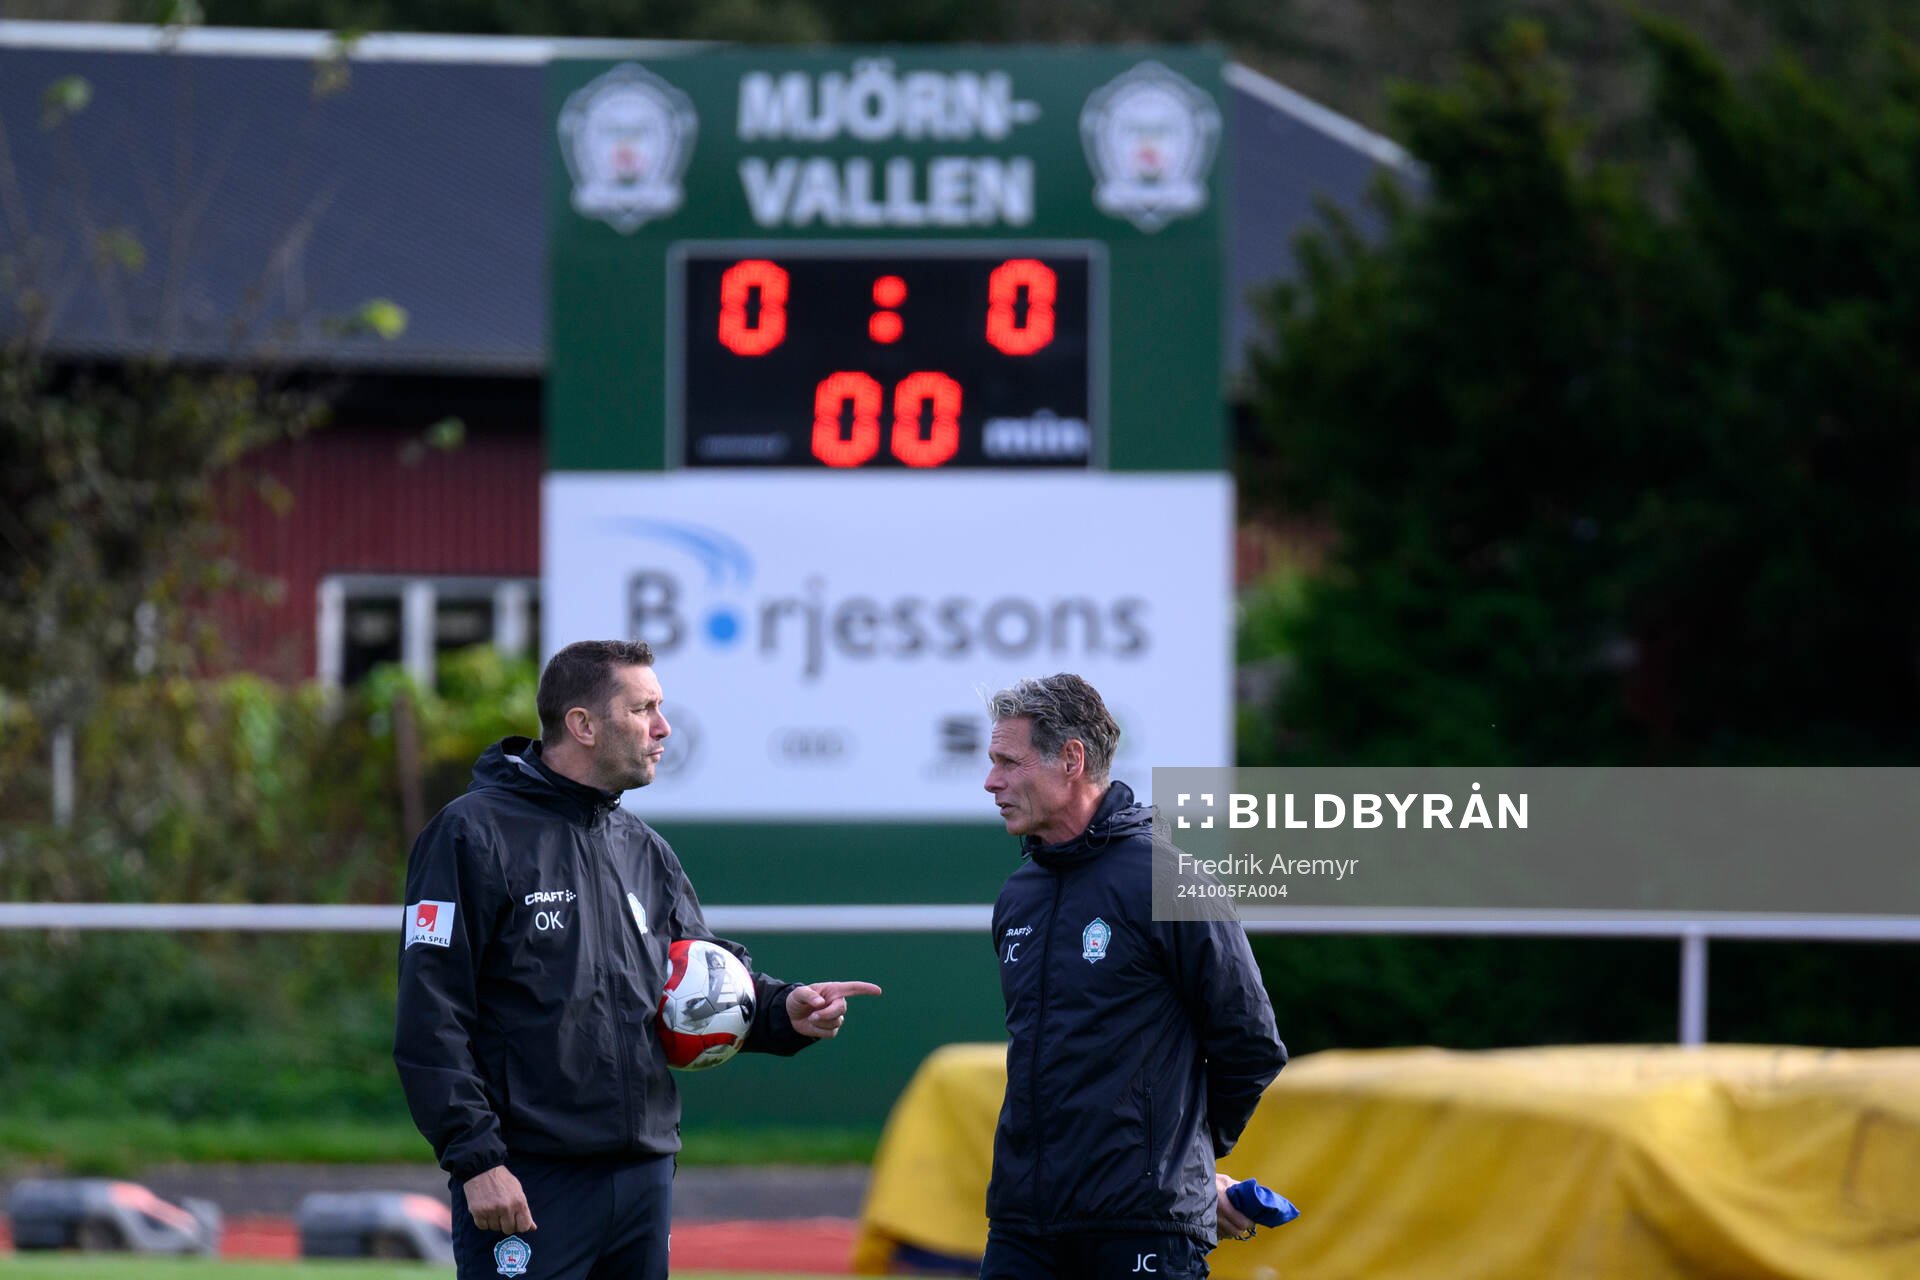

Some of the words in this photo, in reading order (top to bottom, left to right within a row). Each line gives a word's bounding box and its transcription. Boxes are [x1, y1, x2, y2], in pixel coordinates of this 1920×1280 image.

[739, 59, 1040, 141] MJÖRN-
[739, 157, 1035, 226] VALLEN
[811, 371, 963, 468] 00
[981, 408, 1091, 458] min
[524, 891, 564, 906] CRAFT
[535, 910, 564, 931] OK
[428, 935, 449, 946] SPEL
[1004, 943, 1020, 963] JC
[1132, 1253, 1157, 1273] JC
